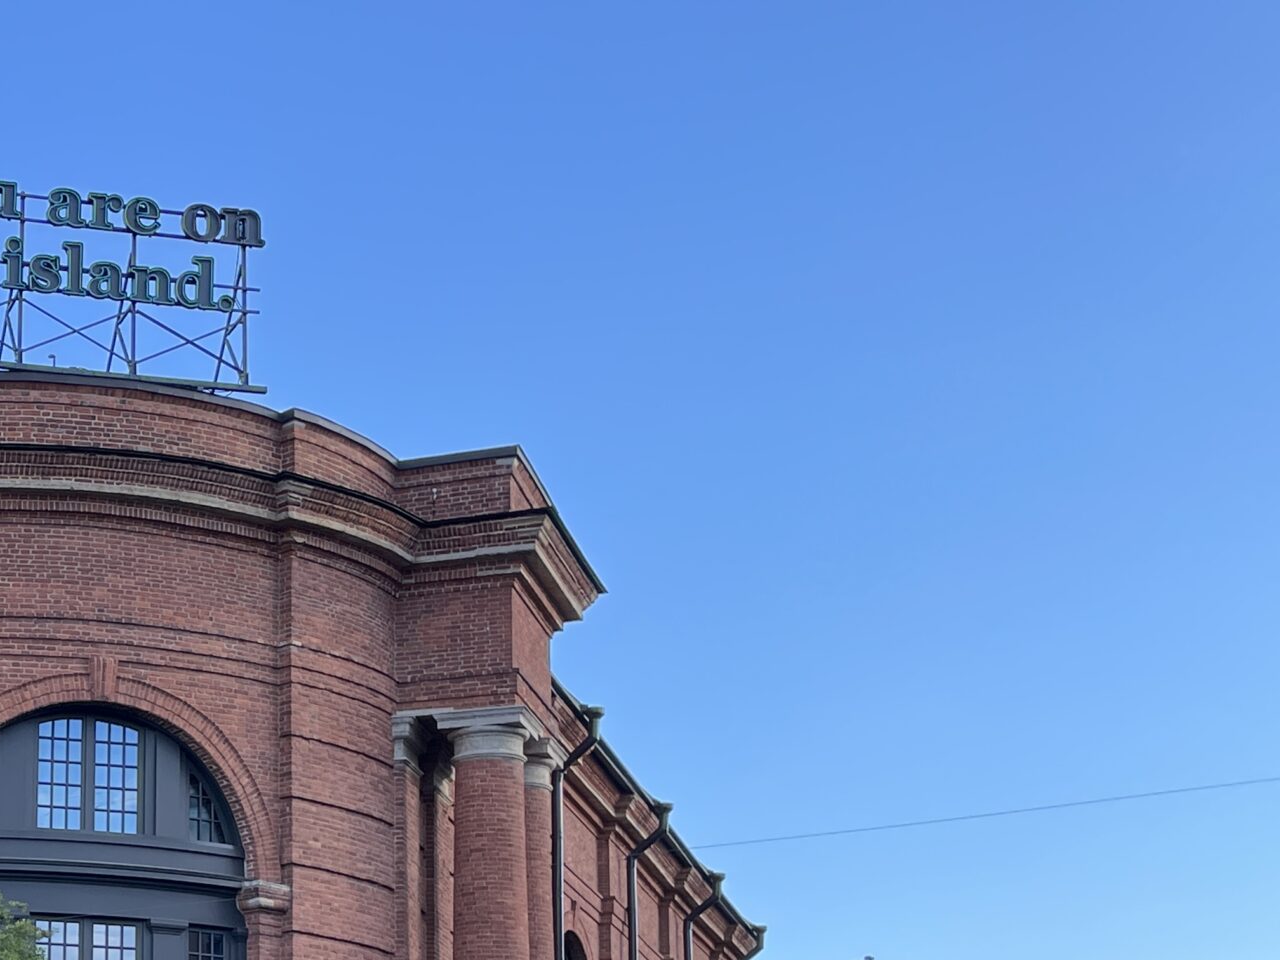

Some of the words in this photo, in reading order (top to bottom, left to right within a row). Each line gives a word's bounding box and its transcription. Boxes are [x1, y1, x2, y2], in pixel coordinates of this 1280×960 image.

[47, 187, 161, 236] are
[180, 202, 266, 248] on
[1, 235, 234, 312] island.
